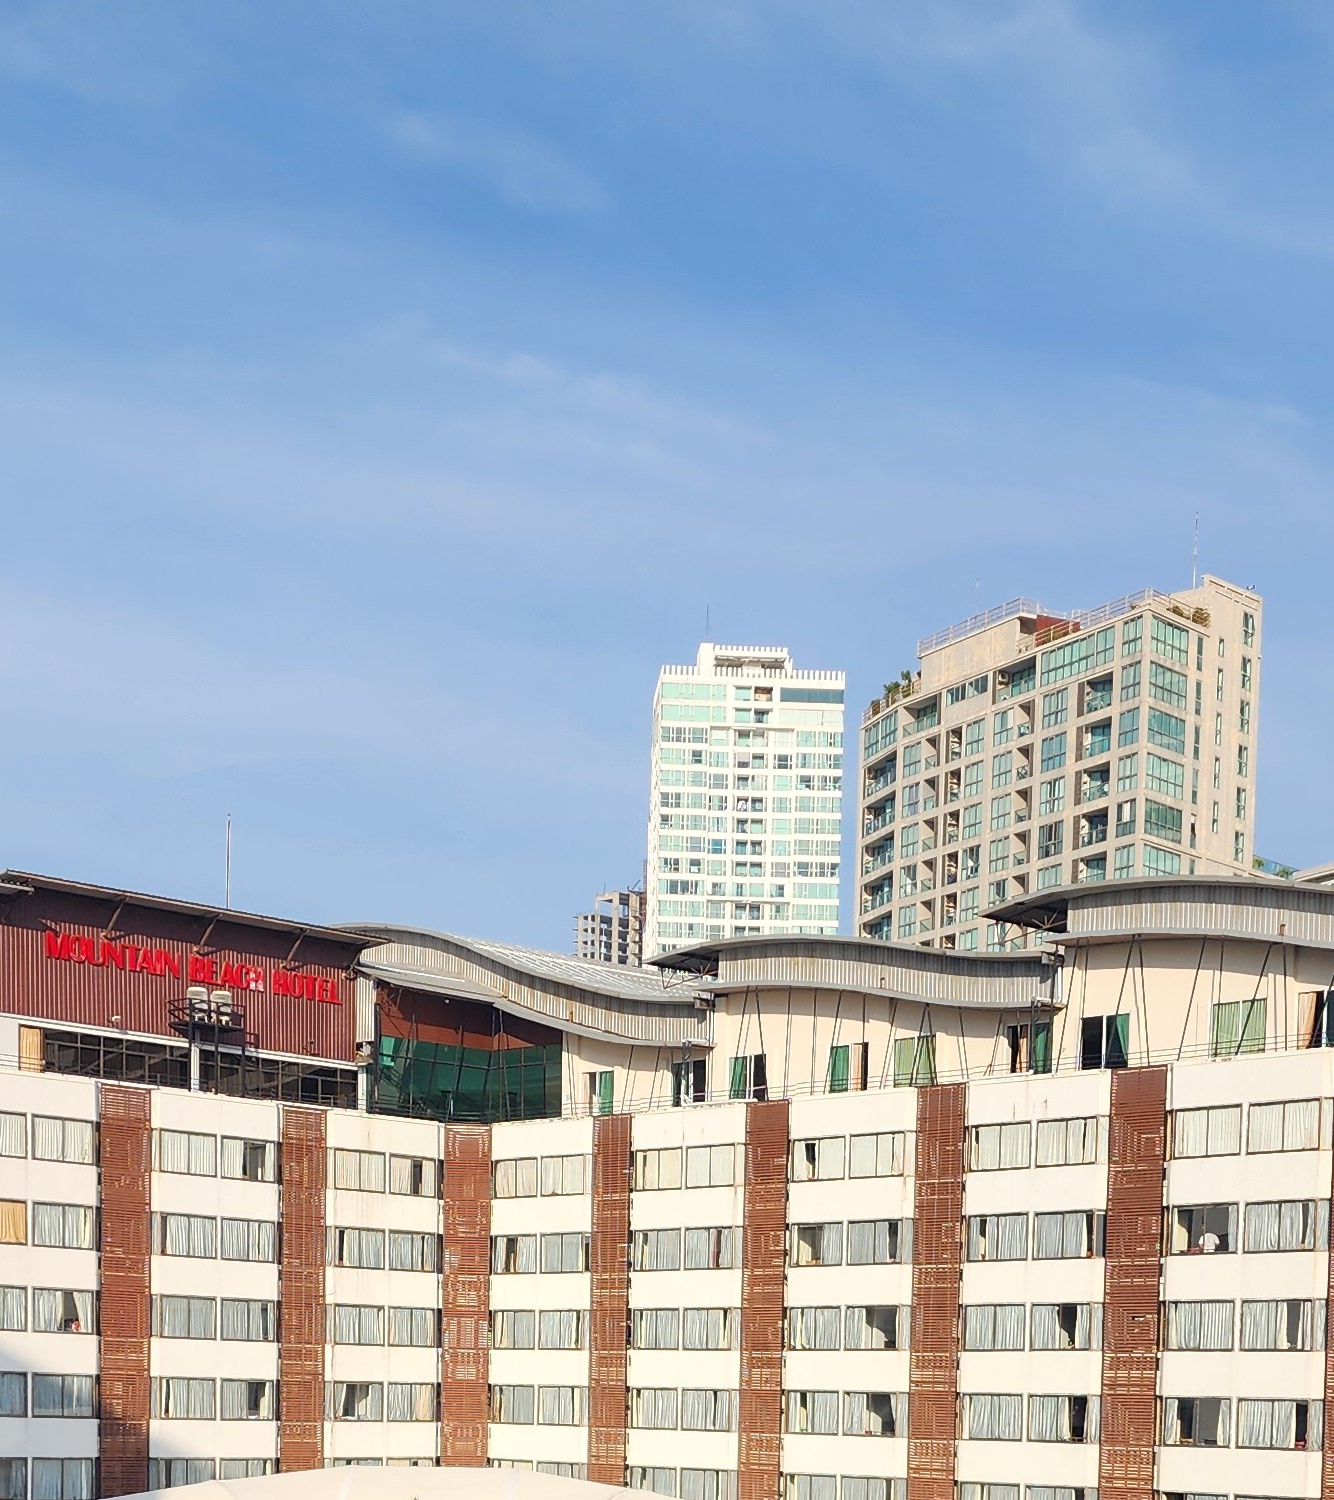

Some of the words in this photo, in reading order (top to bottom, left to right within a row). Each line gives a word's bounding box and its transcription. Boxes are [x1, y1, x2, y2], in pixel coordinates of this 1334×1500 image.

[45, 930, 181, 979] MOUNTAIN
[188, 953, 264, 992] BEACH
[271, 968, 343, 1005] HOTEL
